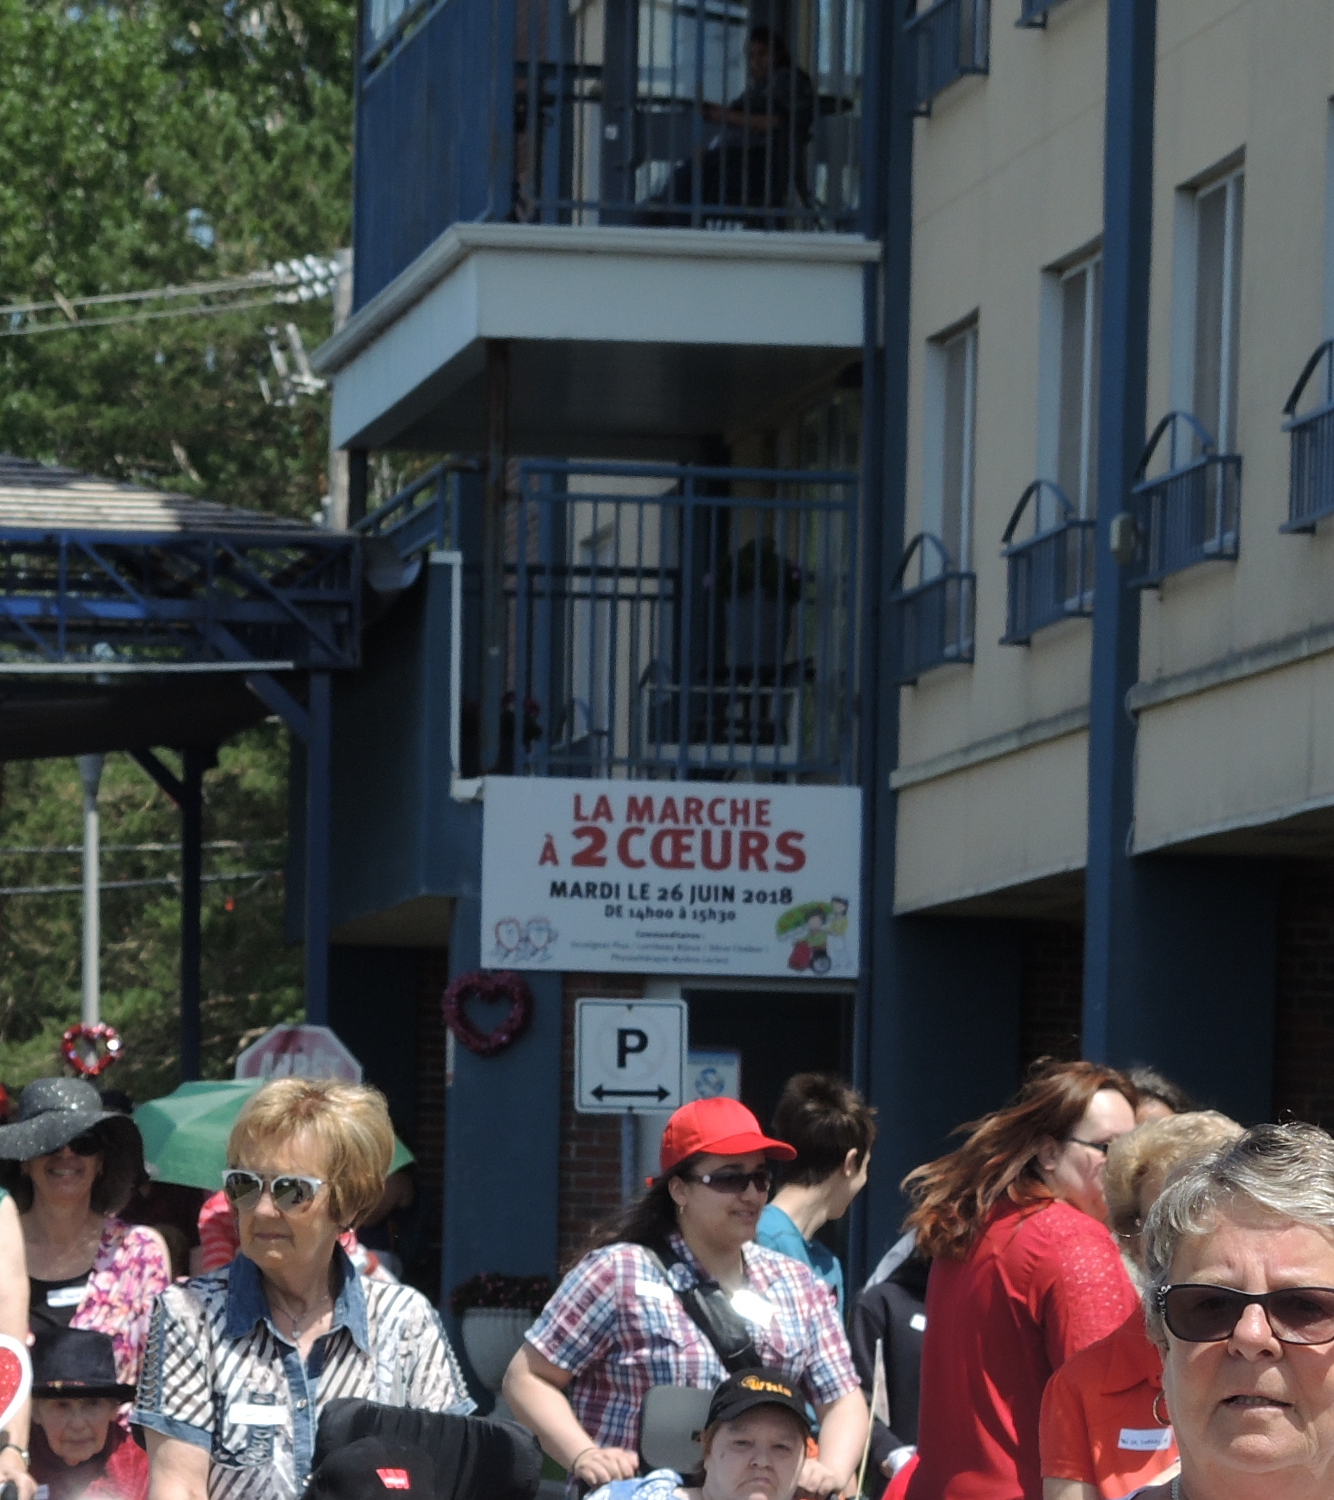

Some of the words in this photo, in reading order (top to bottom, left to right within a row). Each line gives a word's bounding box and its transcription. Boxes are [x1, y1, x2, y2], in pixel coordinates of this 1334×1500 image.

[573, 793, 614, 823] LA
[626, 795, 772, 826] MARCHE
[538, 833, 559, 866] À
[571, 826, 608, 867] 2
[617, 826, 806, 872] CŒURS
[550, 881, 620, 899] MARDI
[628, 882, 650, 900] LE
[657, 884, 683, 901] 26
[690, 885, 735, 905] JUIN
[742, 888, 793, 905] 2018
[604, 905, 622, 918] DE
[615, 1028, 648, 1068] P
